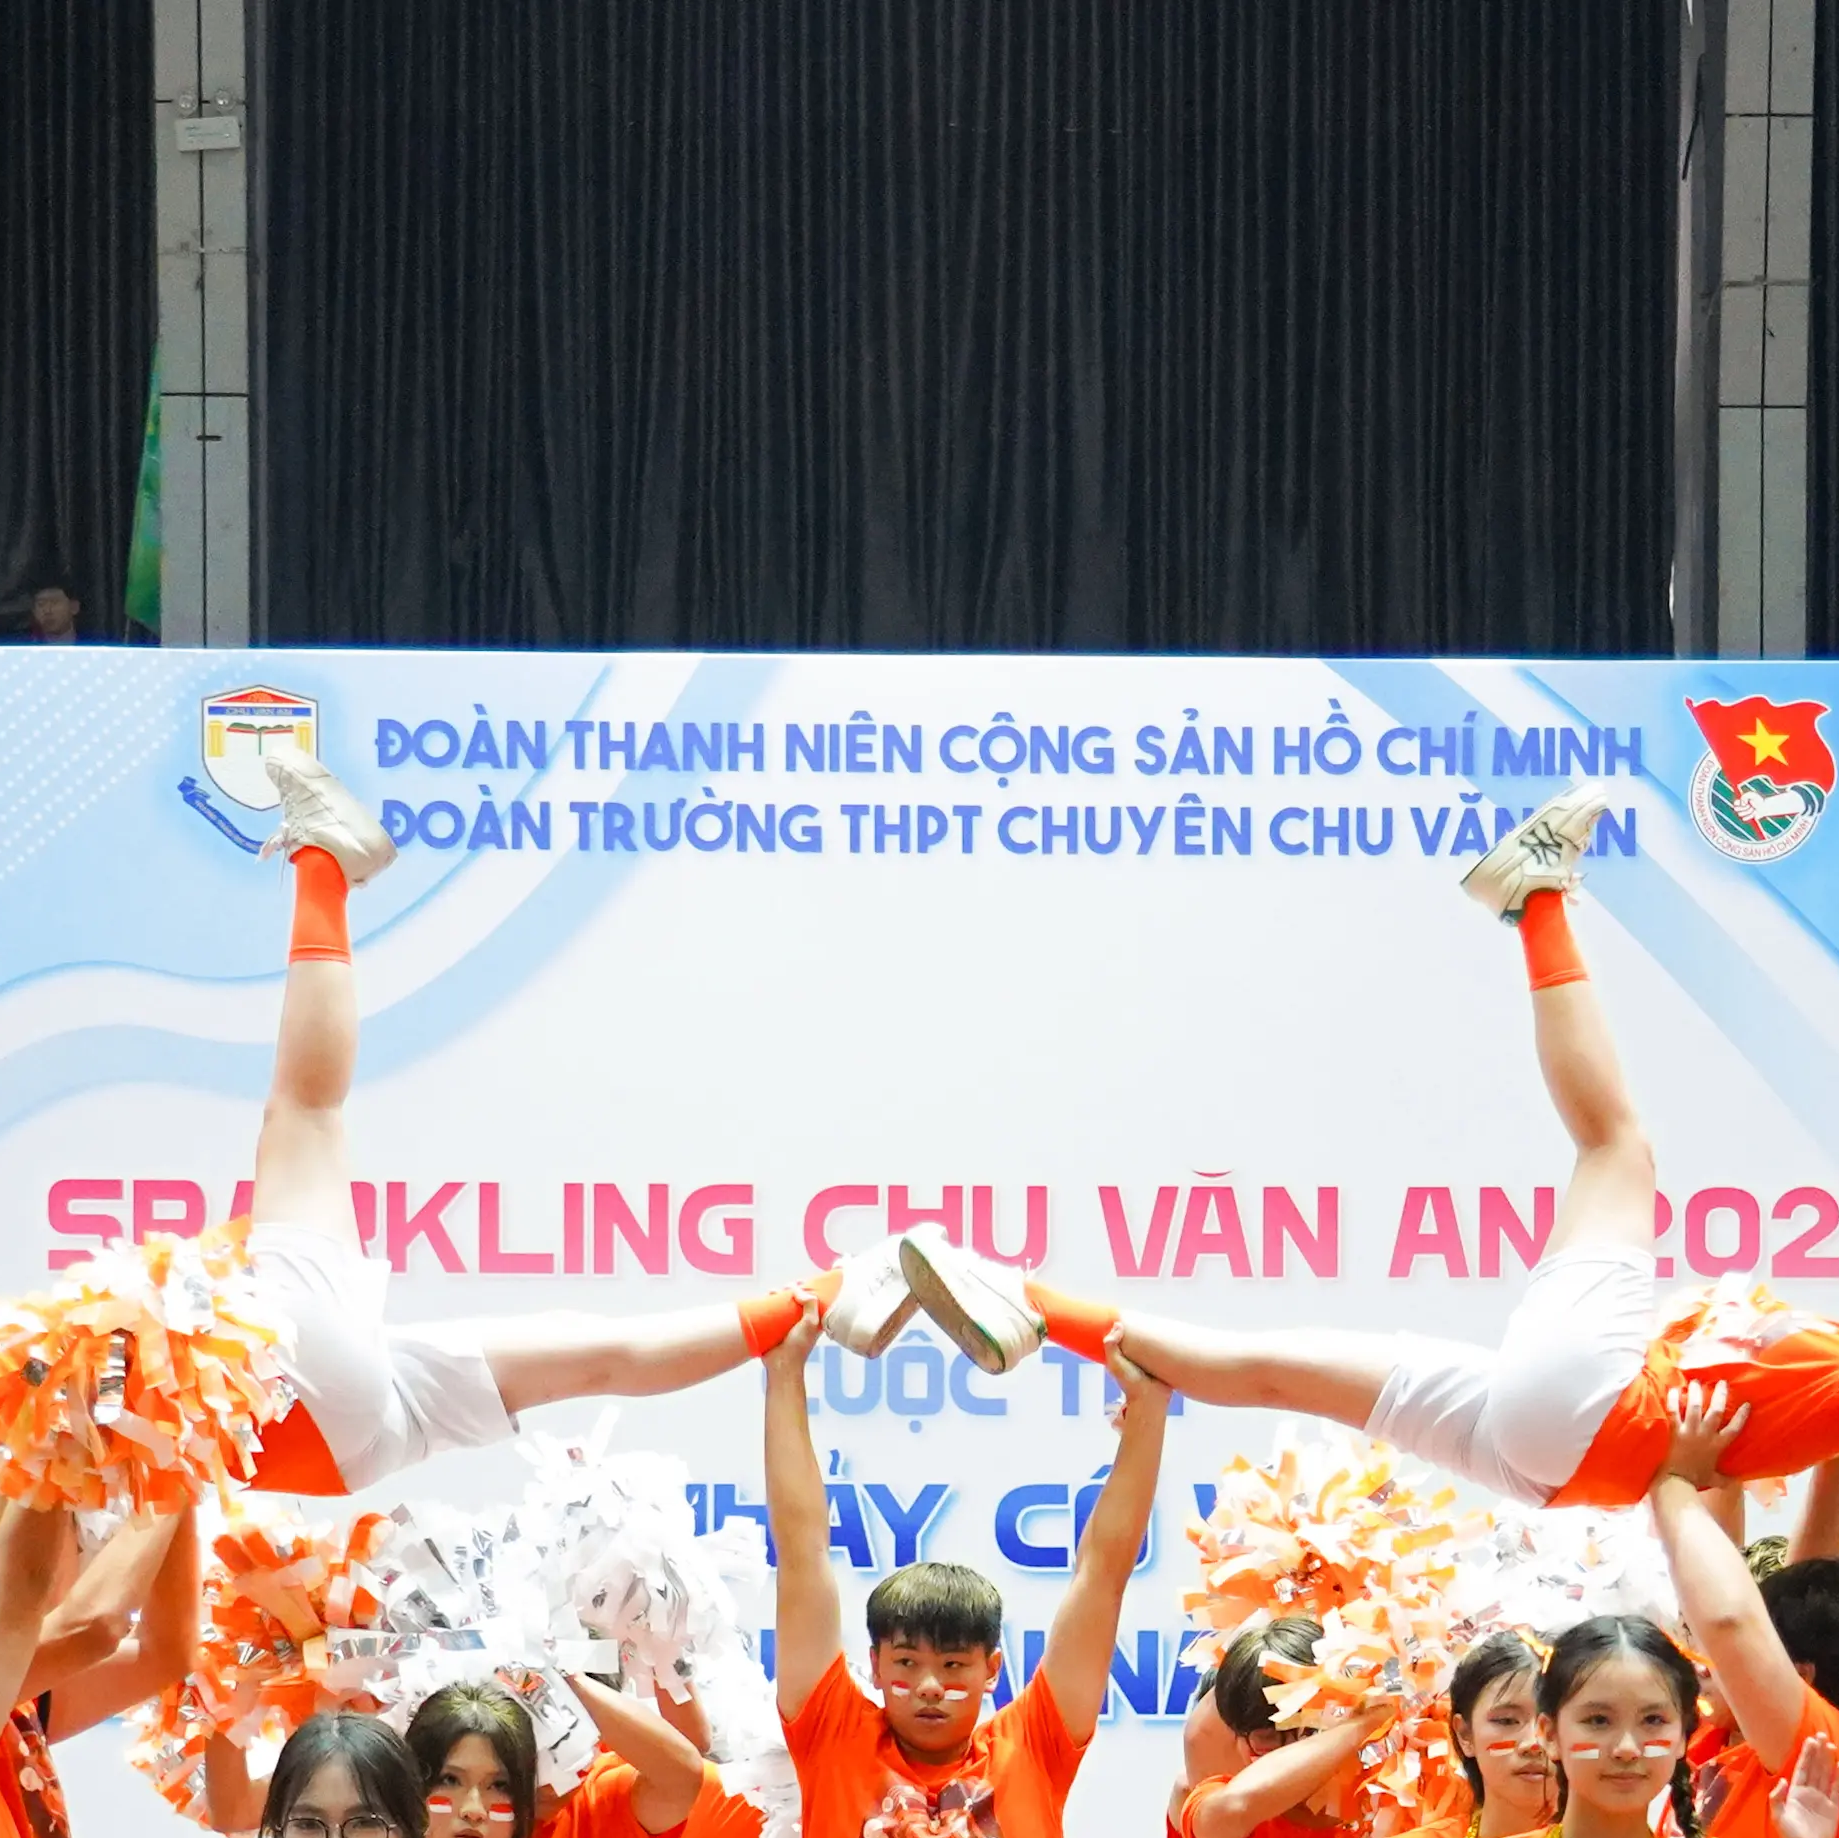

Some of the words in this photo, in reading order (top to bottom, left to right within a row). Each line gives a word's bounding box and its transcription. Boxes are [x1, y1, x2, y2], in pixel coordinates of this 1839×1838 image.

[375, 704, 548, 770] ĐOÀN
[565, 720, 764, 772] THANH
[785, 710, 923, 773] NIÊN
[939, 711, 1115, 788] CỘNG
[1134, 708, 1254, 776] SẢN
[1274, 698, 1362, 776] HỒ
[1377, 711, 1478, 776] CHÍ
[1491, 727, 1642, 776] MINH
[381, 784, 551, 850] ĐOÀN
[568, 786, 823, 853] TRƯỜNG
[840, 805, 982, 854] THPT
[998, 793, 1253, 856] CHUYÊN
[1269, 807, 1393, 857] CHU
[1586, 808, 1636, 858] N
[48, 1179, 754, 1275] SPKLING
[802, 1184, 1050, 1276] CHU
[1097, 1169, 1339, 1278] VĂN
[1387, 1186, 1556, 1278] AN
